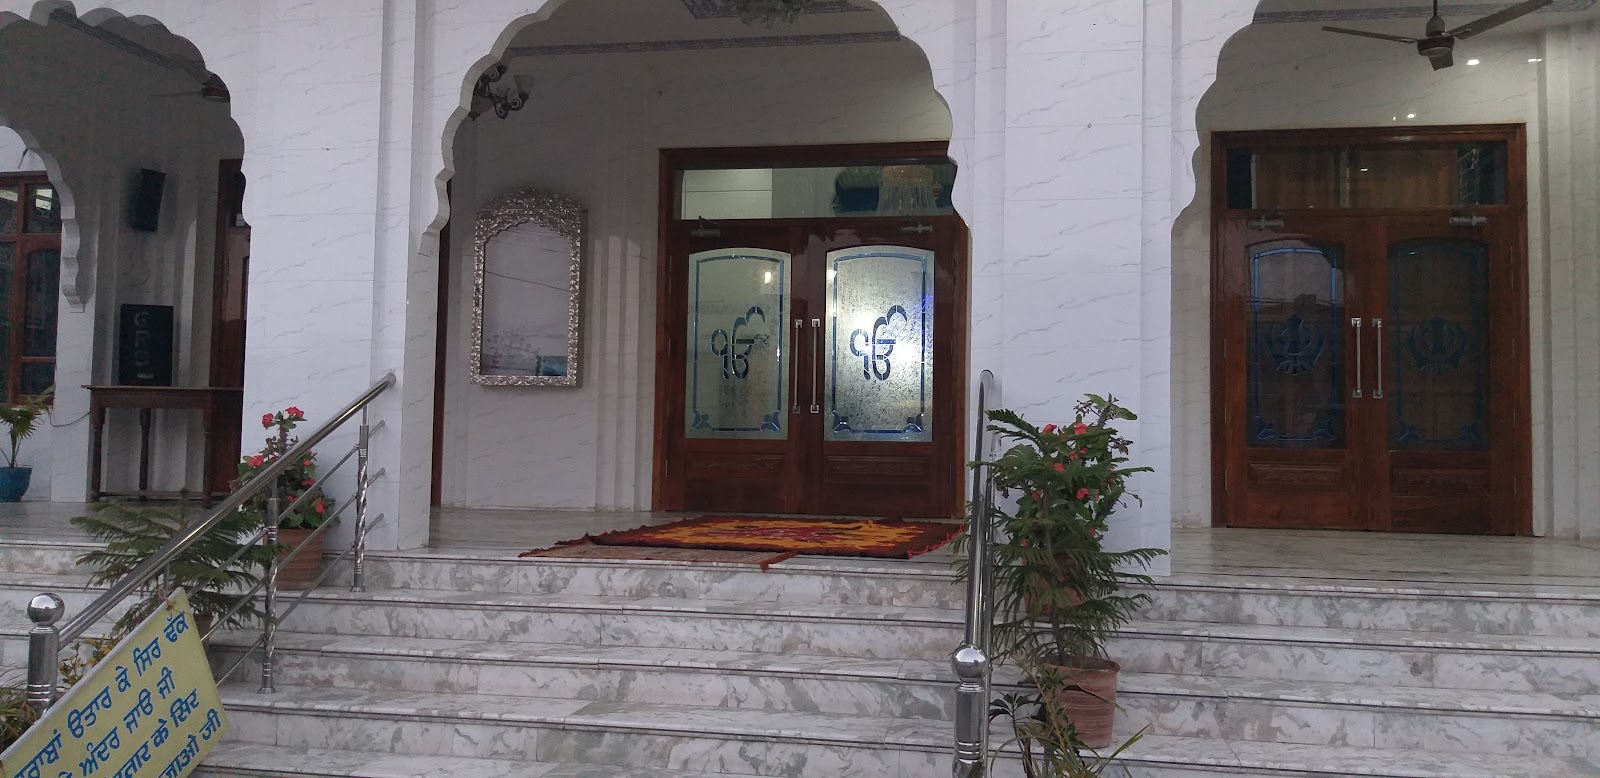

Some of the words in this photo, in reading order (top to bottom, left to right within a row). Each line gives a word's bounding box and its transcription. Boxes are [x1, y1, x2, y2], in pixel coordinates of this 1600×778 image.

[115, 665, 132, 693] ਕੇ
[133, 636, 161, 677] ਸਿਰ
[163, 611, 189, 643] ਢੱਕ
[79, 726, 120, 777] ਅੰਦਰ
[156, 666, 176, 700] ਜੀ
[150, 718, 169, 748] के
[170, 688, 199, 728] सिर
[199, 708, 221, 741] जी
